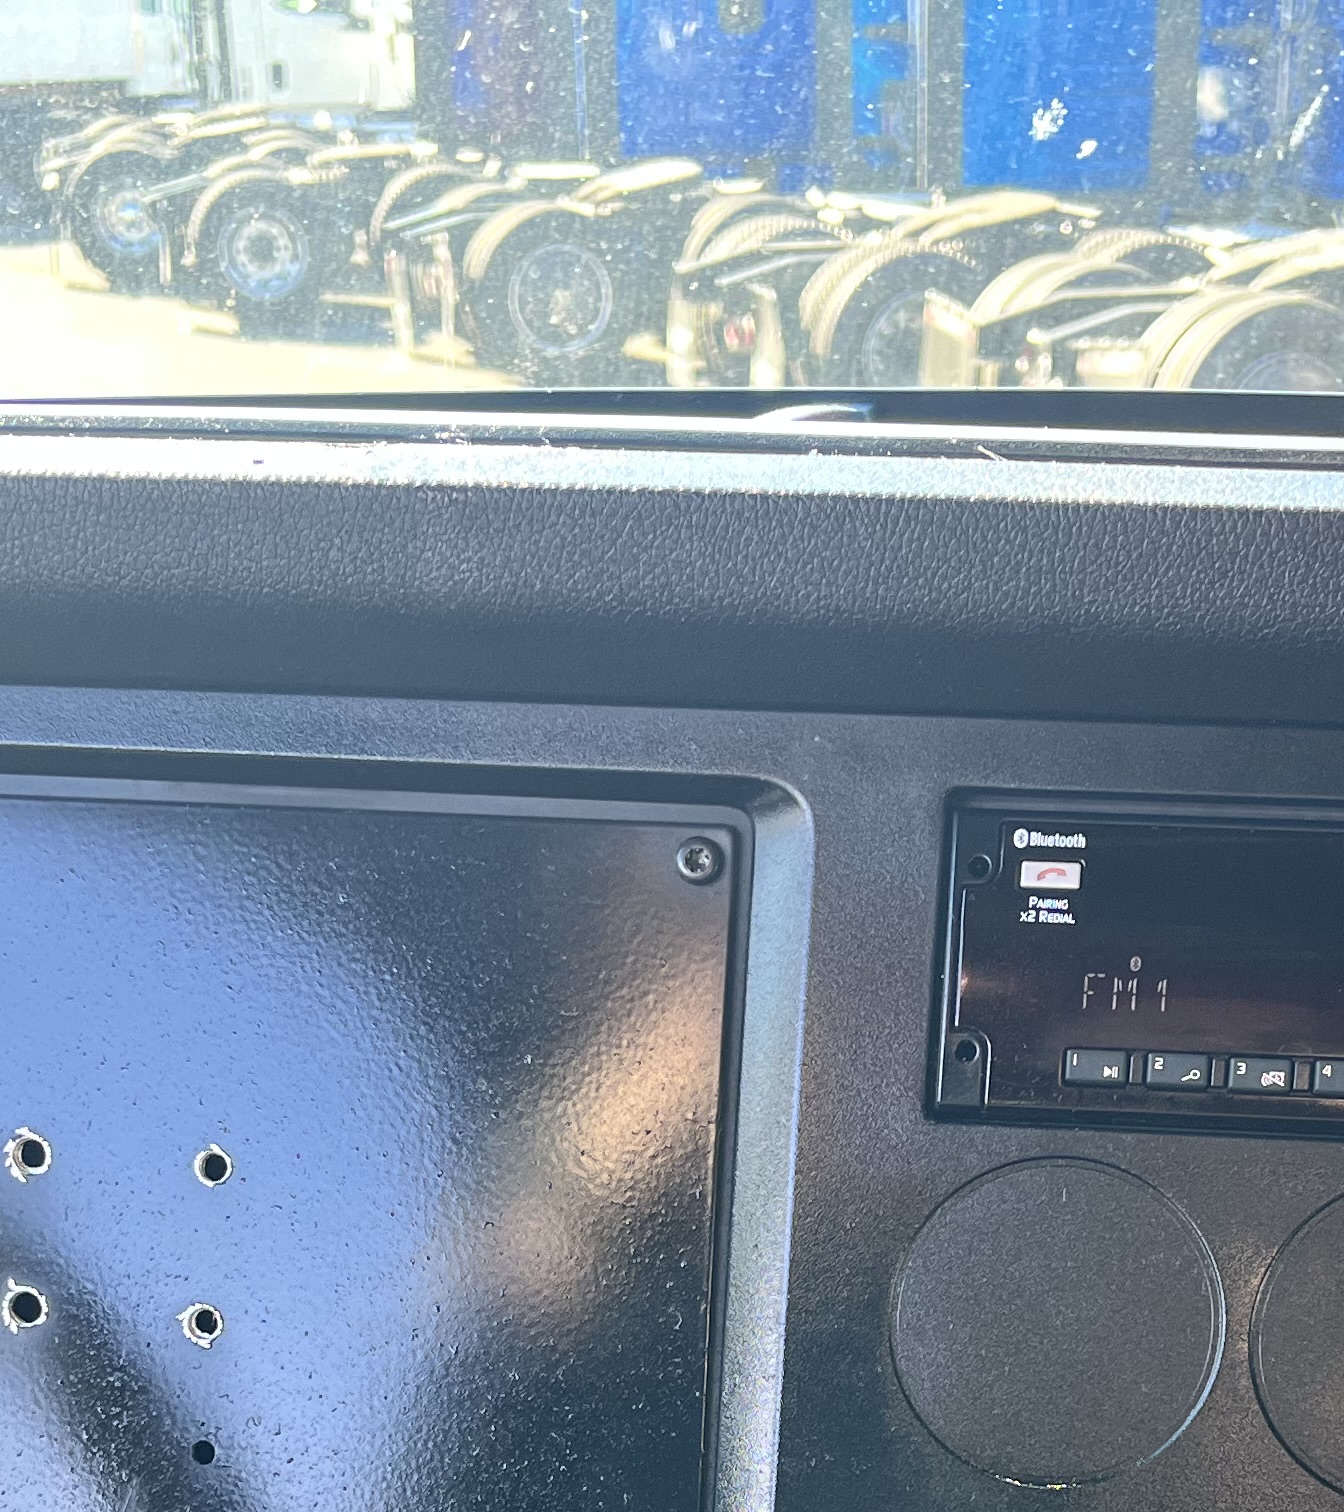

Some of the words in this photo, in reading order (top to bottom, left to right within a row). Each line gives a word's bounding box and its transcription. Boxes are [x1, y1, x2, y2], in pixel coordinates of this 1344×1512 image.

[1029, 831, 1086, 849] Bluetooth
[1153, 1057, 1164, 1070] 2
[1236, 1062, 1247, 1076] 3
[1321, 1065, 1333, 1079] 4
